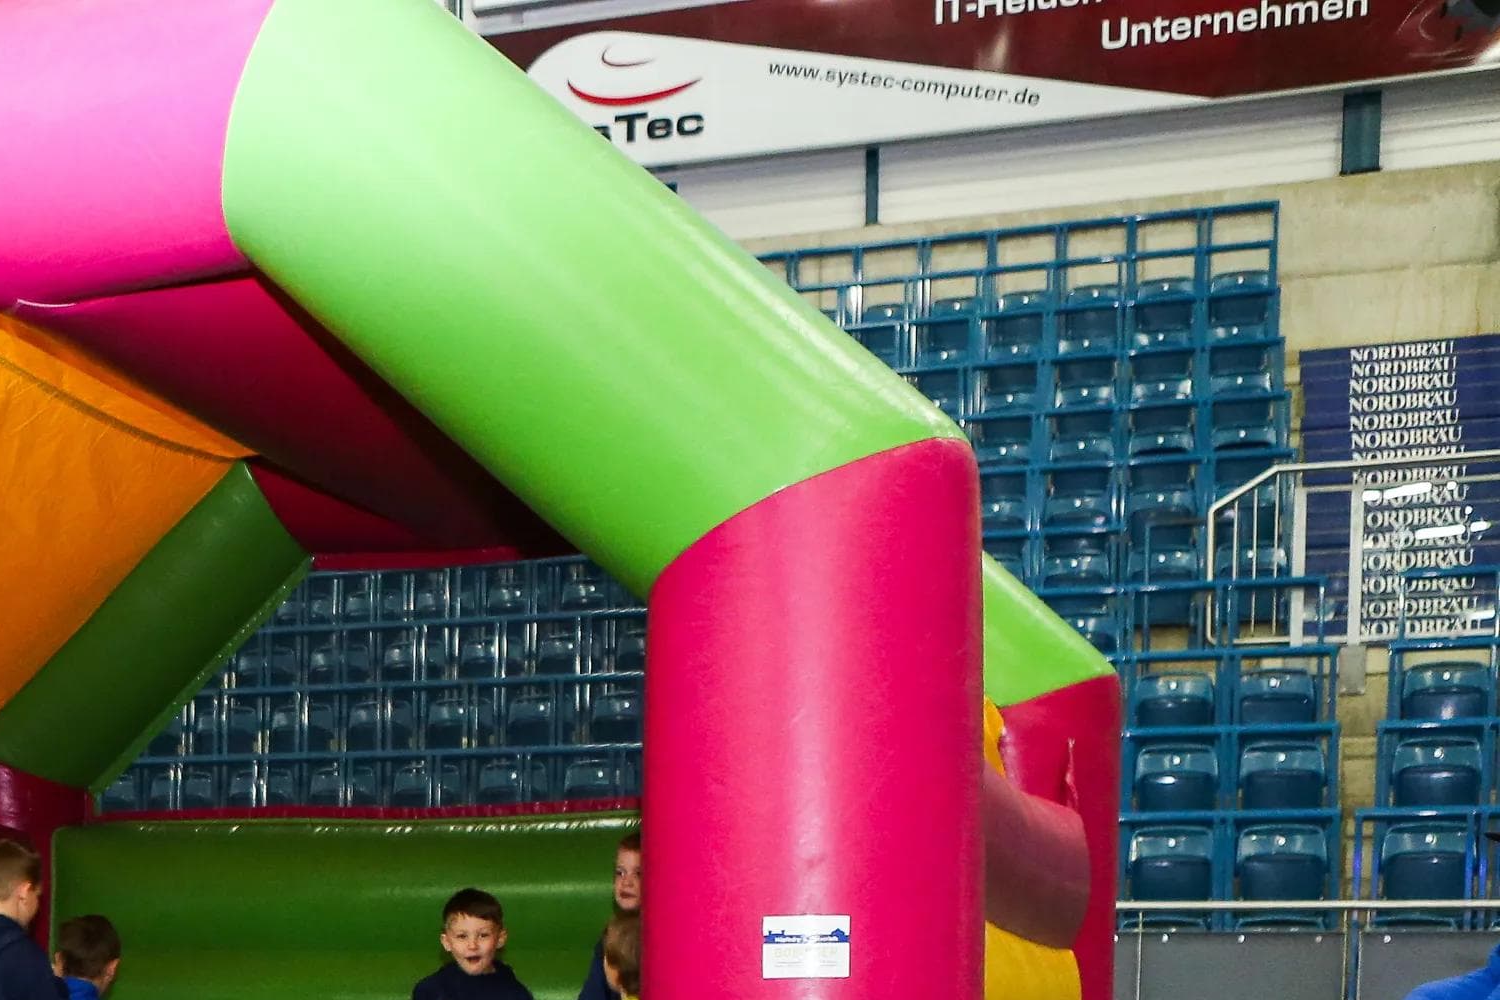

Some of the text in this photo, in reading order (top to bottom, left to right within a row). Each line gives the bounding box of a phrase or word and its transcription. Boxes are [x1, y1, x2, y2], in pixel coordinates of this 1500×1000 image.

[934, 0, 1101, 26] IT-He
[1101, 0, 1369, 49] Unternehmen
[768, 60, 1042, 107] www.systec-computer.de
[1349, 340, 1455, 362] NORDBRÄU
[1351, 356, 1457, 378] NORDBRÄU
[1349, 371, 1456, 396] NORDBRÄU
[1349, 390, 1458, 413] NORDBRÄU
[1349, 408, 1460, 432] NORDBRÄU
[1351, 426, 1463, 450] NORDBRÄU
[1366, 505, 1471, 530] ORDBRÄU
[1363, 548, 1474, 572] ORDBRÄU
